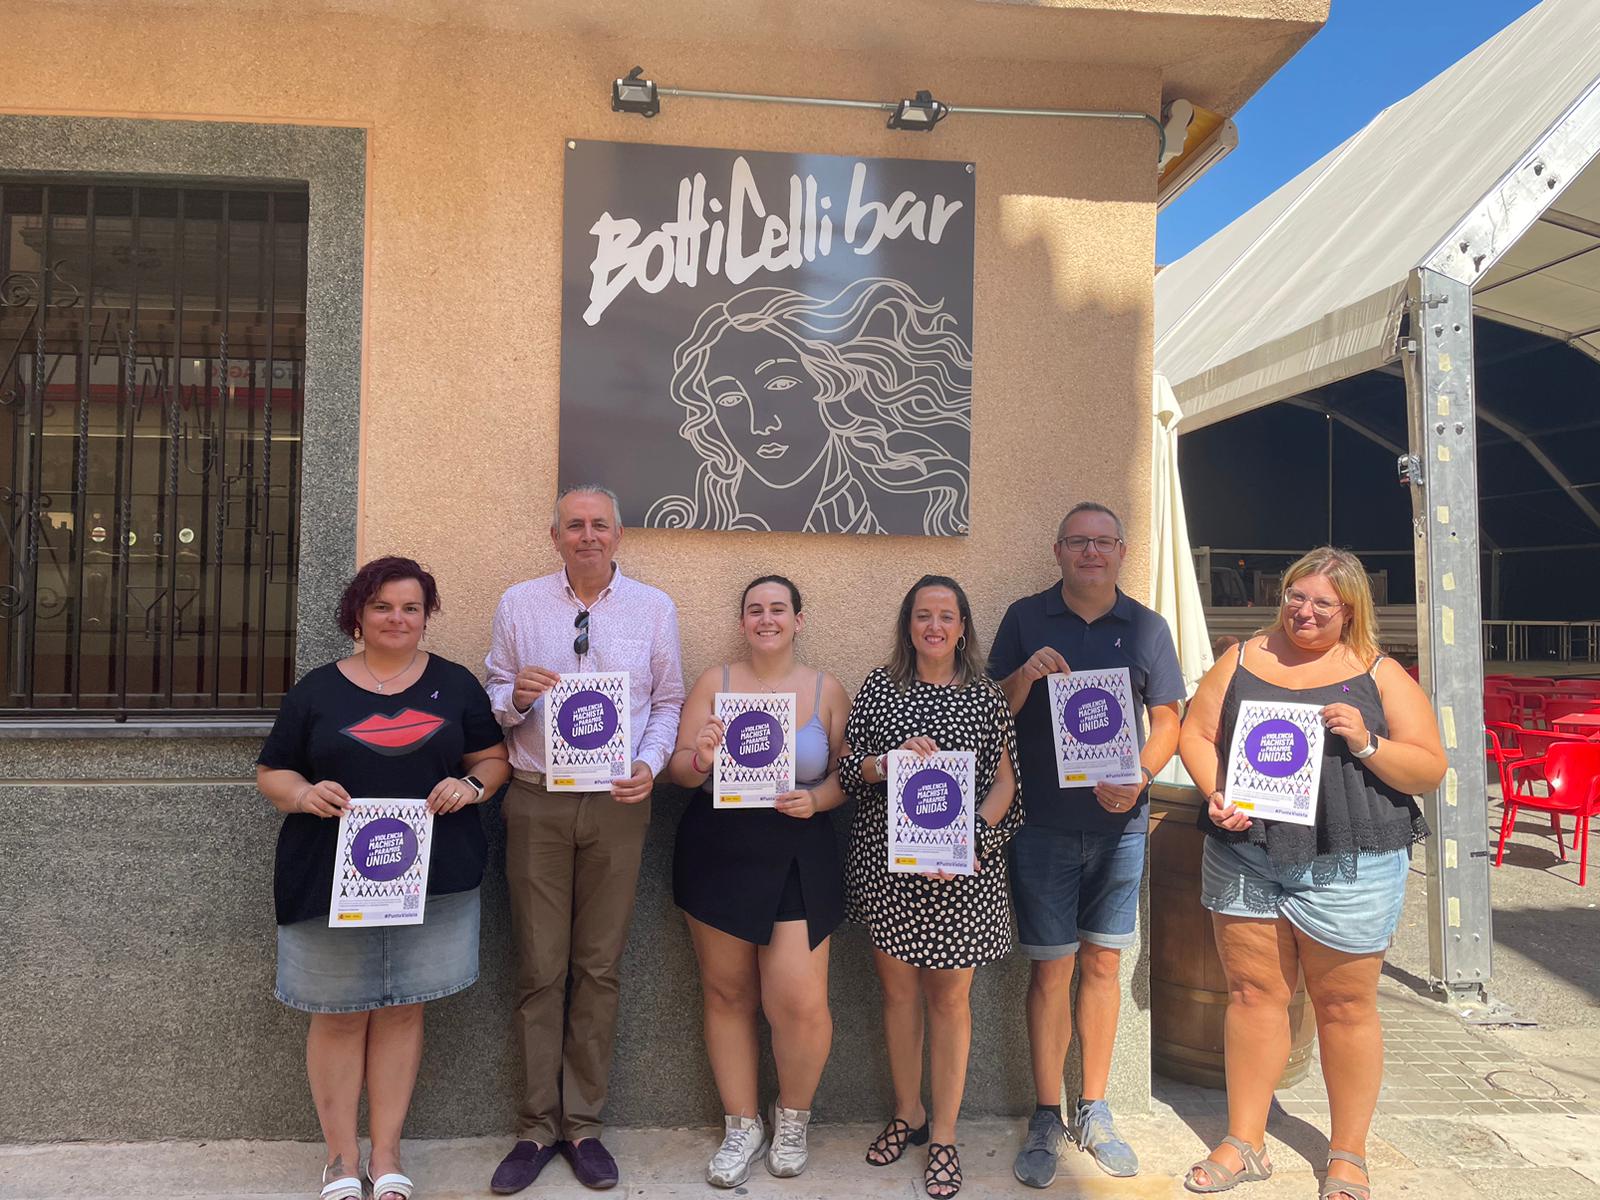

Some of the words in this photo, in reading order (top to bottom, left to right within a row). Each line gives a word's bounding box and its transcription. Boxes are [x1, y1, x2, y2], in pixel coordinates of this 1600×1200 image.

[844, 162, 963, 255] bar
[577, 703, 602, 712] VIOLENCIA
[1082, 699, 1106, 708] VIOLENCIA
[573, 708, 604, 721] MACHISTA
[1078, 706, 1108, 718] MACHISTA
[1085, 712, 1107, 721] PARAMOS
[578, 717, 602, 726] PARAMOS
[1079, 718, 1109, 733] UNIDAS
[572, 722, 603, 737] UNIDAS
[745, 723, 769, 732] VIOLENCIA
[741, 729, 770, 740] MACHISTA
[740, 741, 770, 755] UNIDAS
[1258, 751, 1292, 762] UNIDAS
[922, 782, 947, 790] VIOLENCIA
[917, 788, 948, 799] MACHISTA
[916, 802, 947, 815] UNIDAS
[375, 832, 403, 842] VIOLENCIA
[369, 838, 403, 850] MACHISTA
[375, 846, 401, 855] PARAMOS
[366, 852, 402, 867] UNIDAS
